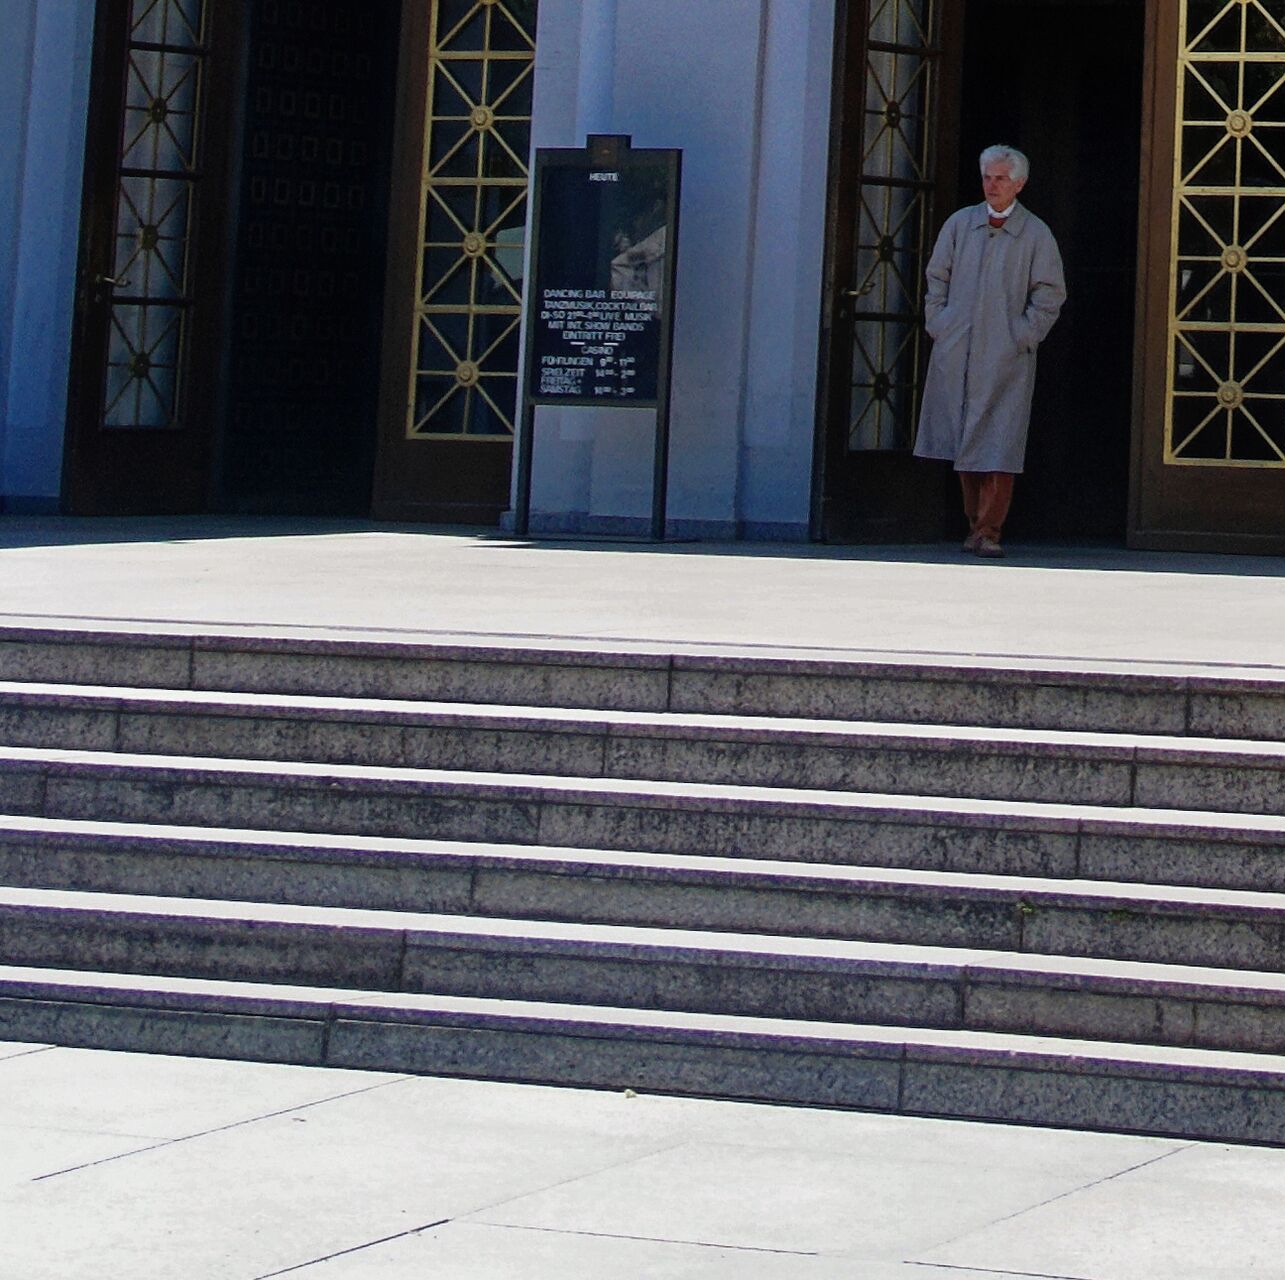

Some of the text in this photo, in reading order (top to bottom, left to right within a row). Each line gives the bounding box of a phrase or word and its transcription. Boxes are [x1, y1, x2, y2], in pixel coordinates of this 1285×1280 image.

[543, 289, 656, 300] DANCING BAR EQUIPAGE
[624, 313, 652, 321] MUSIK
[548, 321, 565, 329] MIT
[584, 321, 610, 330] SHOW
[613, 322, 645, 331] BANDS
[562, 331, 626, 341] EINTRITT FREI
[581, 346, 614, 355] CASINO
